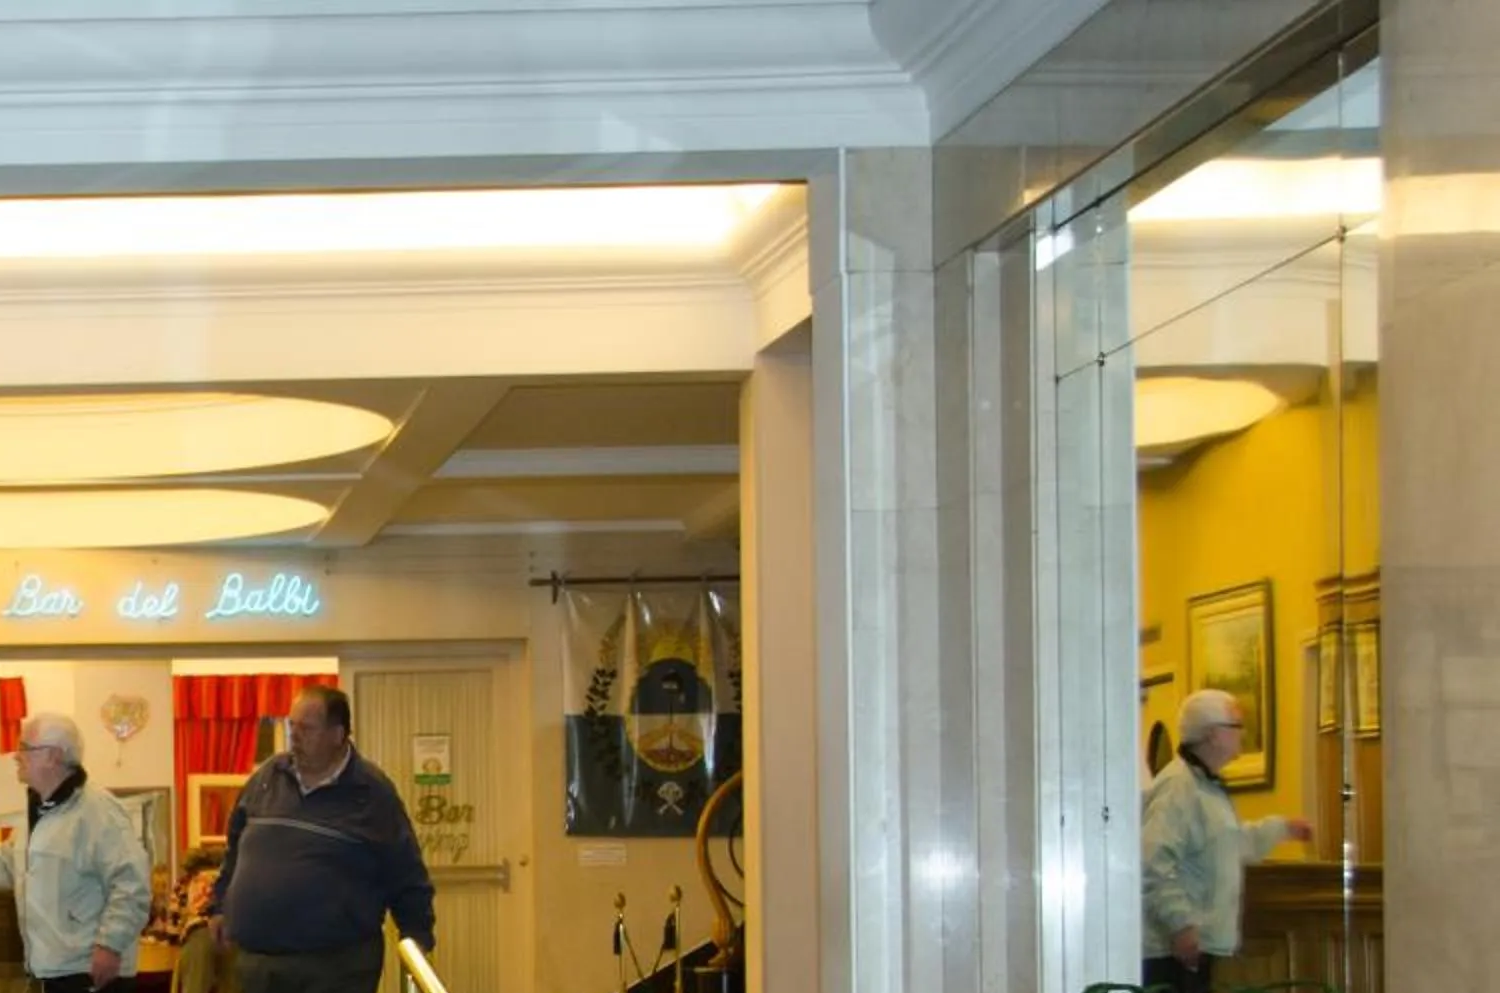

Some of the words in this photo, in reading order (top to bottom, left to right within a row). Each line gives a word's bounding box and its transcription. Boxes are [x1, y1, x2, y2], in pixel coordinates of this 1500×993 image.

[2, 574, 84, 617] Bar
[116, 580, 180, 619] del
[204, 572, 321, 619] Balbi
[415, 794, 475, 825] Bar
